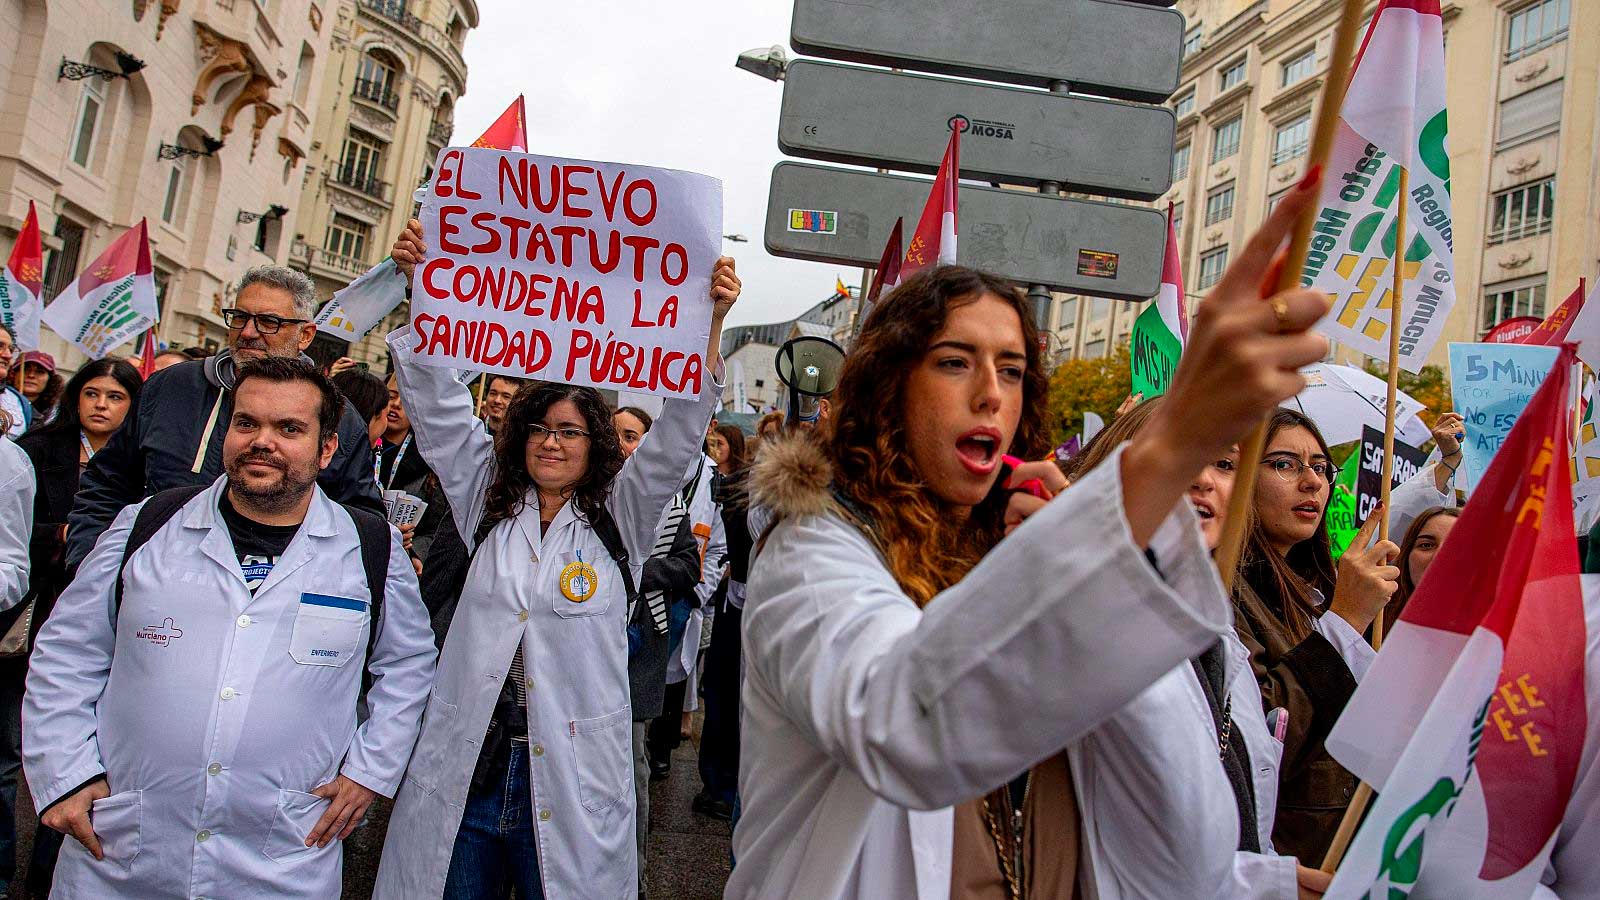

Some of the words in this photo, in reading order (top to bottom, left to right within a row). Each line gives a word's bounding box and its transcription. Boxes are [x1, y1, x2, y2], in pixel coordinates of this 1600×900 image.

[971, 125, 1014, 140] MOSA
[434, 150, 482, 200] EL
[499, 155, 658, 226] NUEVO
[439, 205, 689, 286] ESTATUTO
[422, 257, 606, 325] CONDENA
[631, 288, 679, 329] LA
[413, 312, 553, 374] SANIDAD
[564, 329, 702, 395] PÚBLICA
[1465, 354, 1489, 382] 5
[1464, 406, 1487, 425] NO
[136, 631, 167, 641] Murciano
